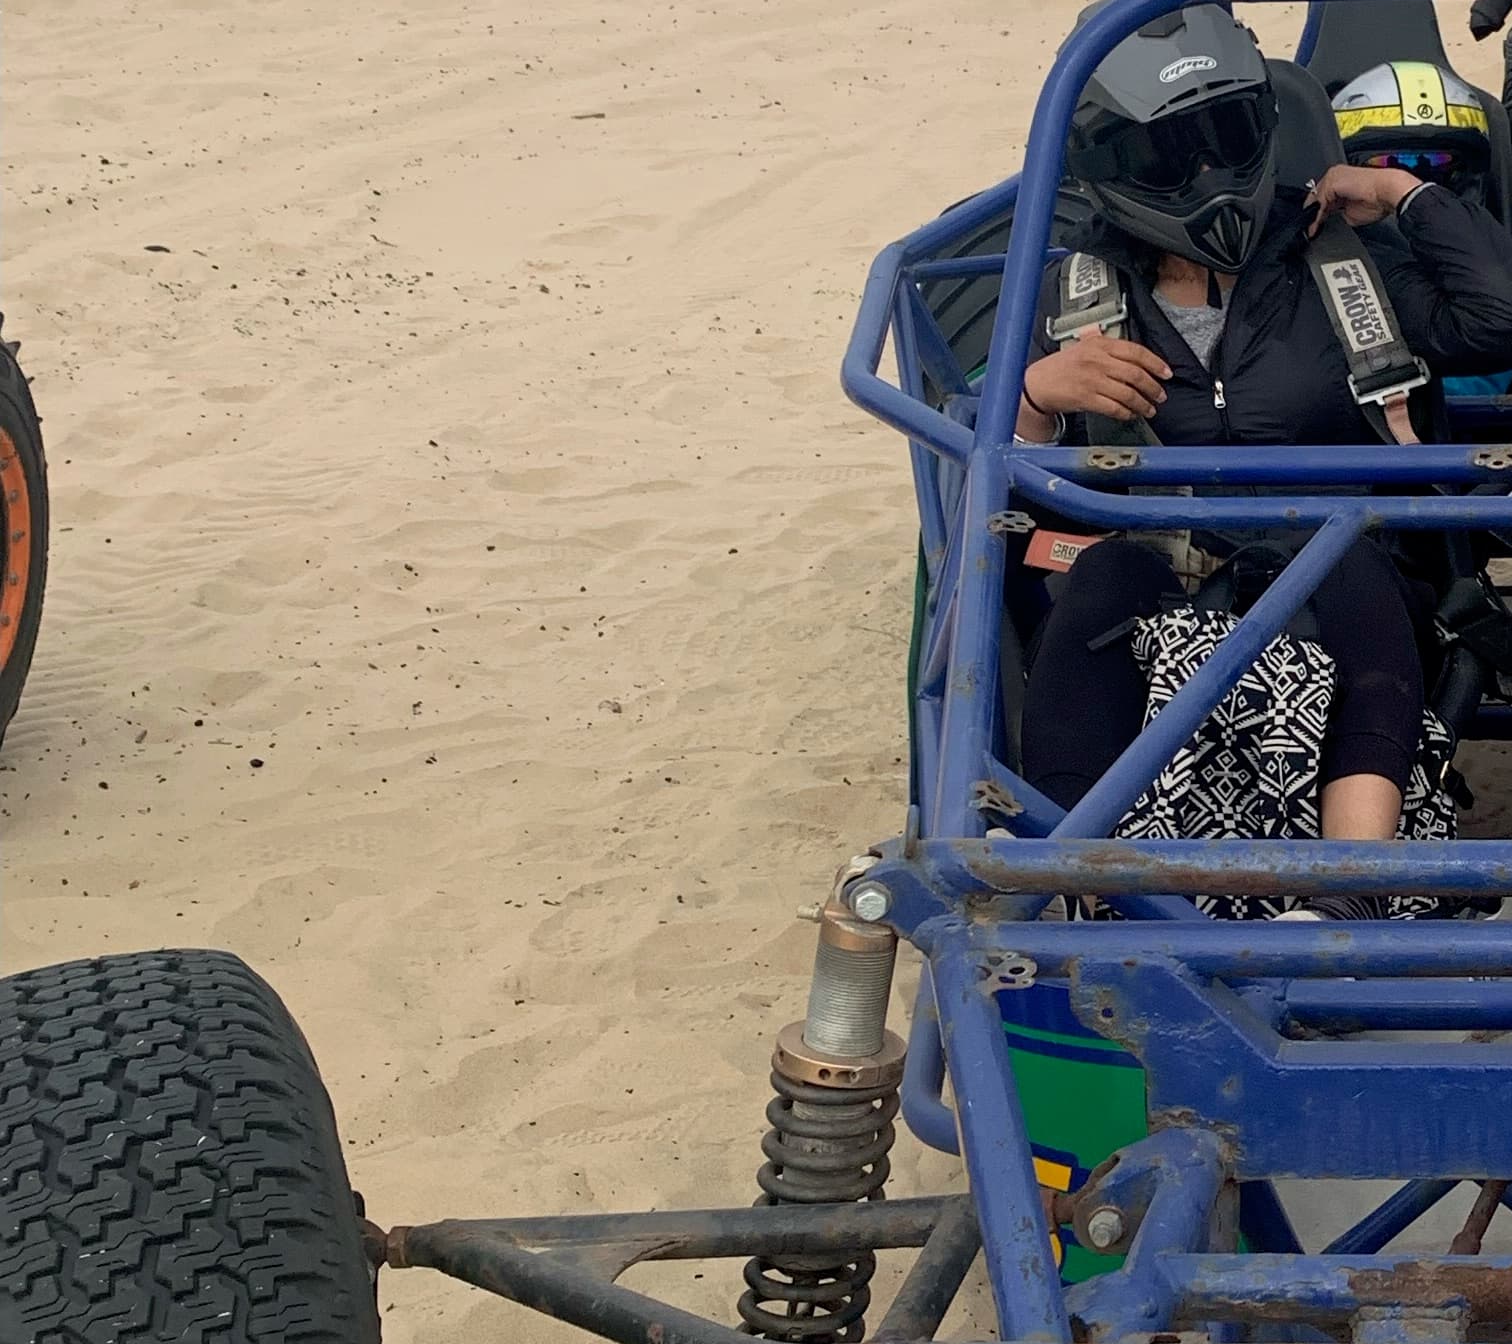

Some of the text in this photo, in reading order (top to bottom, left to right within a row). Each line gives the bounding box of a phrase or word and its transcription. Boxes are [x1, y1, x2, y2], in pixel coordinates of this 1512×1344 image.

[1338, 285, 1377, 345] CROW
[1362, 293, 1387, 340] SAFETY
[1053, 543, 1081, 557] CRO
